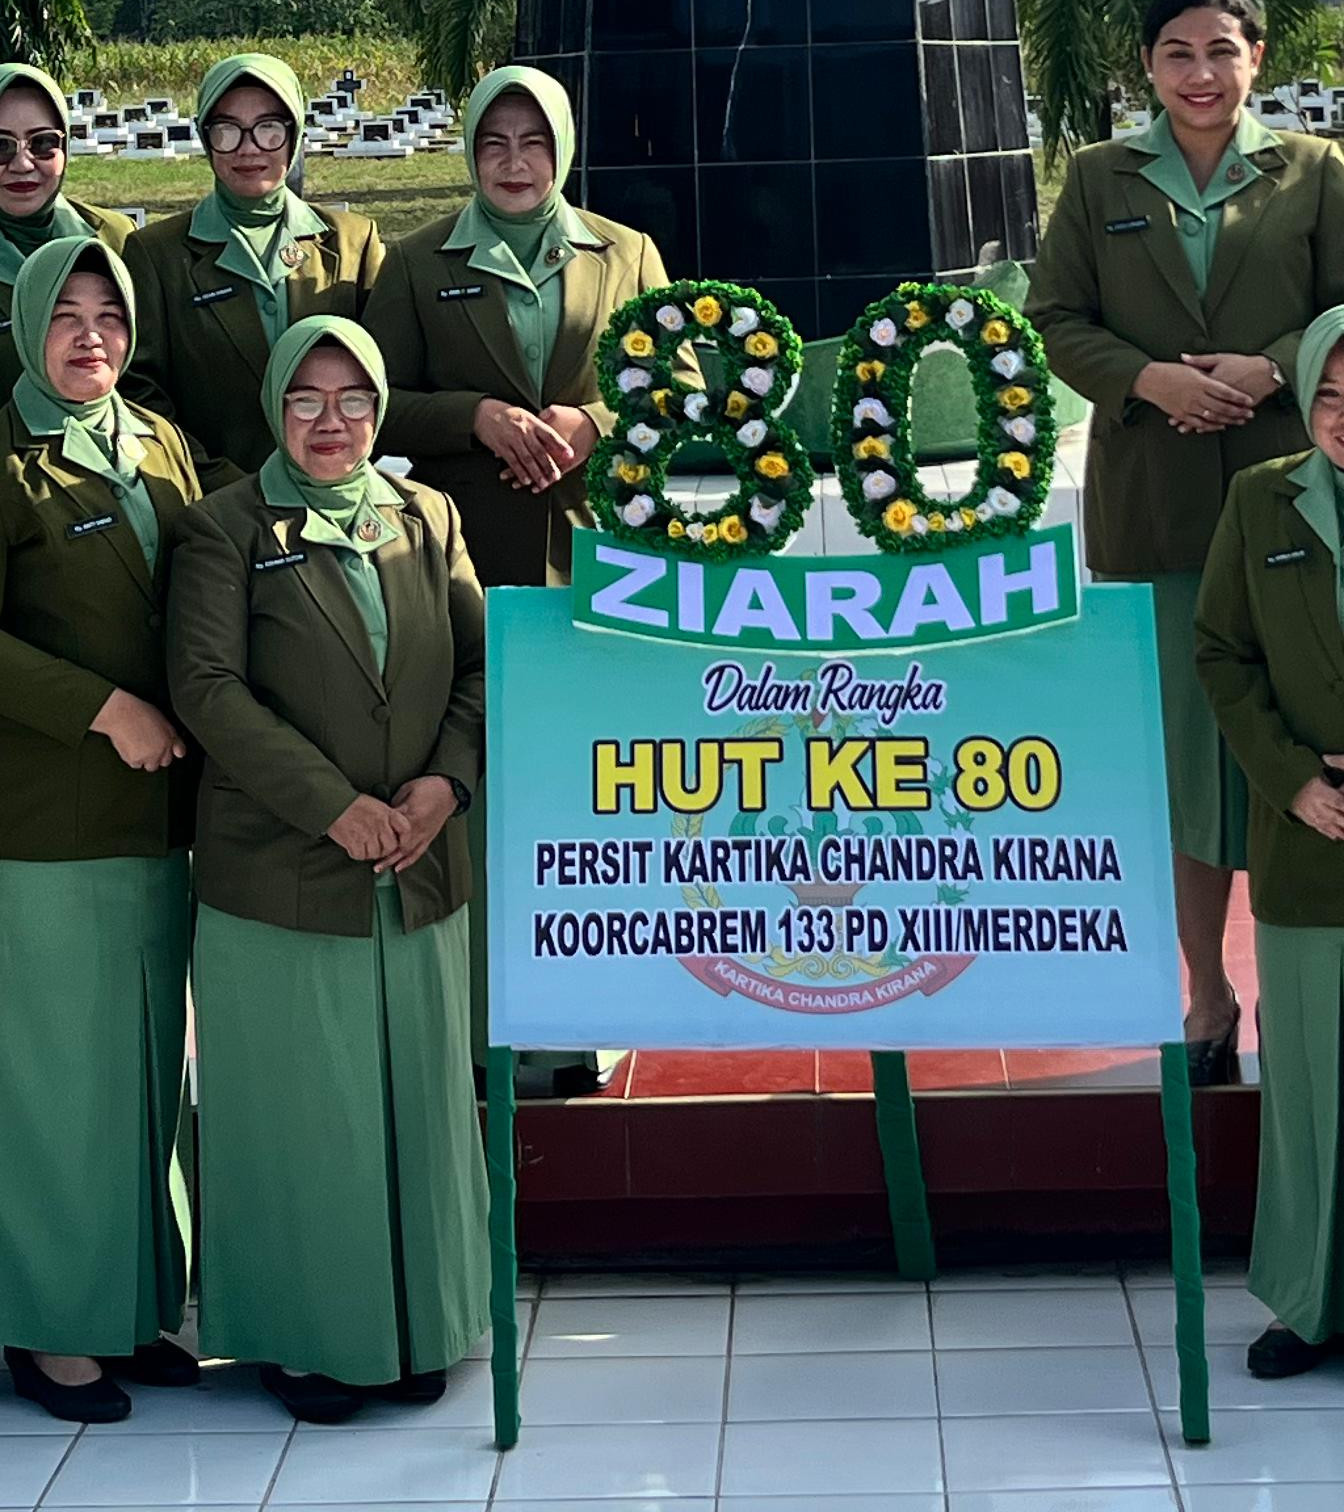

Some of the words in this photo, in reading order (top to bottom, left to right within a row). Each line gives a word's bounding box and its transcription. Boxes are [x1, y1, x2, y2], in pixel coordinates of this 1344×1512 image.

[591, 541, 1060, 642] ZIARAH
[704, 663, 810, 712] Dalam
[816, 663, 945, 725] Rangka
[593, 738, 783, 814] HUT
[806, 735, 931, 811] KE
[955, 736, 1062, 812] 80
[536, 840, 653, 886] PERSIT
[662, 838, 812, 883] KARTIKA
[820, 837, 984, 882] CHANDRA
[992, 837, 1122, 882] KIRANA
[534, 909, 767, 957] KOORCABREM
[777, 908, 835, 954] 133
[845, 908, 889, 953] PD
[897, 908, 1129, 954] XIII/MERDEKA
[713, 959, 786, 1004] KARTIKA
[787, 989, 874, 1009] CHANDRA
[874, 960, 938, 1001] KIRANA
